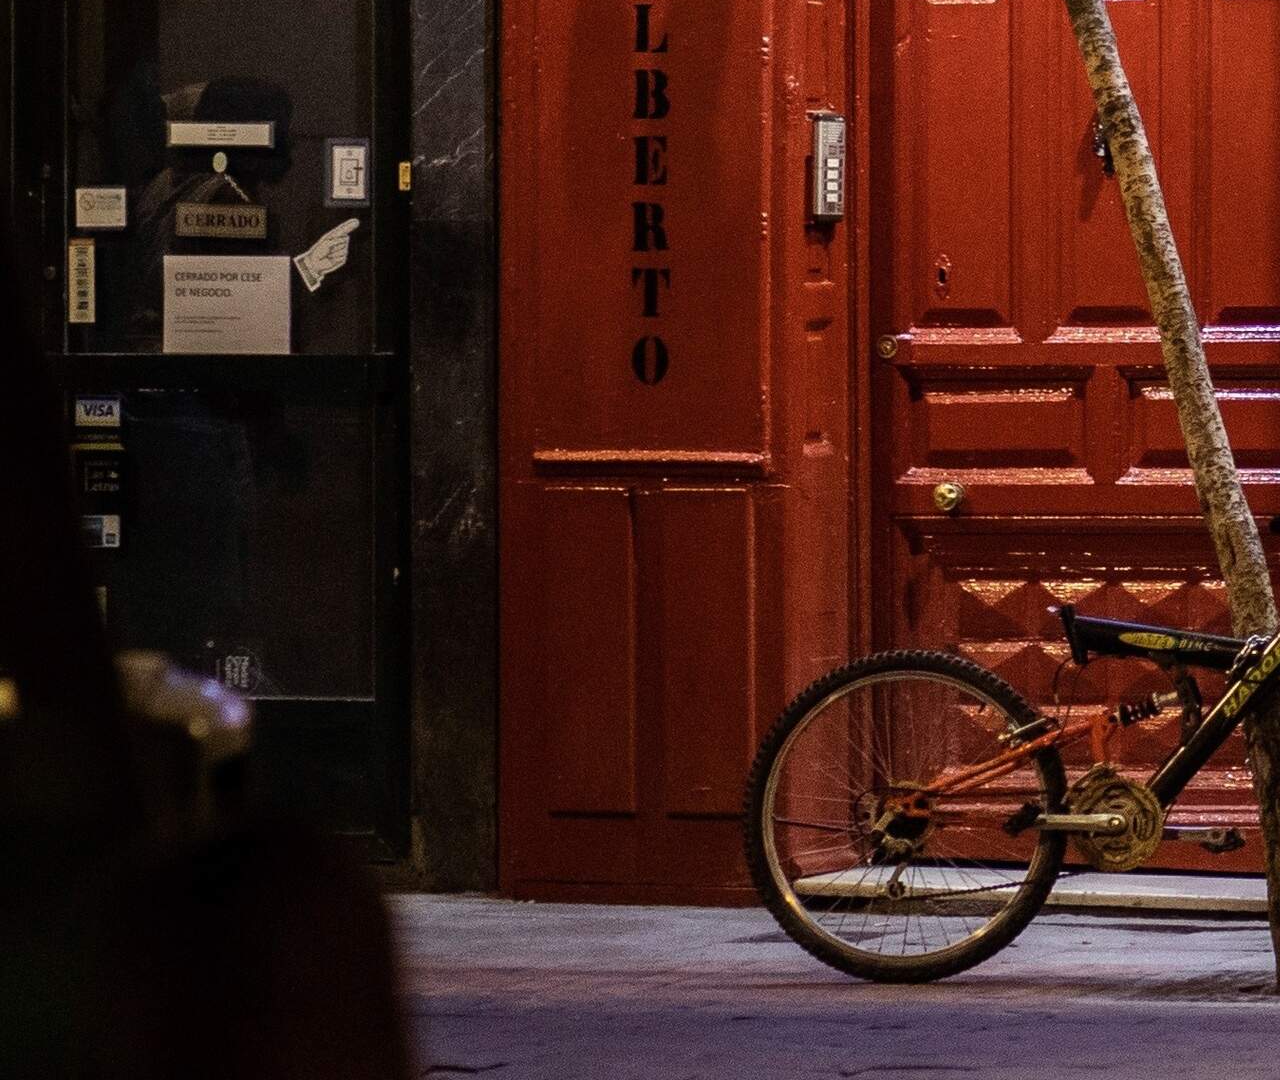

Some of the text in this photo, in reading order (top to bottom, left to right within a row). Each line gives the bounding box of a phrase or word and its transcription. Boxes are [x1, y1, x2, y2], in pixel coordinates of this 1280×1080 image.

[183, 212, 261, 230] CERRADO
[174, 272, 262, 283] CERRADO POR CESE
[174, 287, 188, 298] DE
[82, 404, 114, 418] VISA
